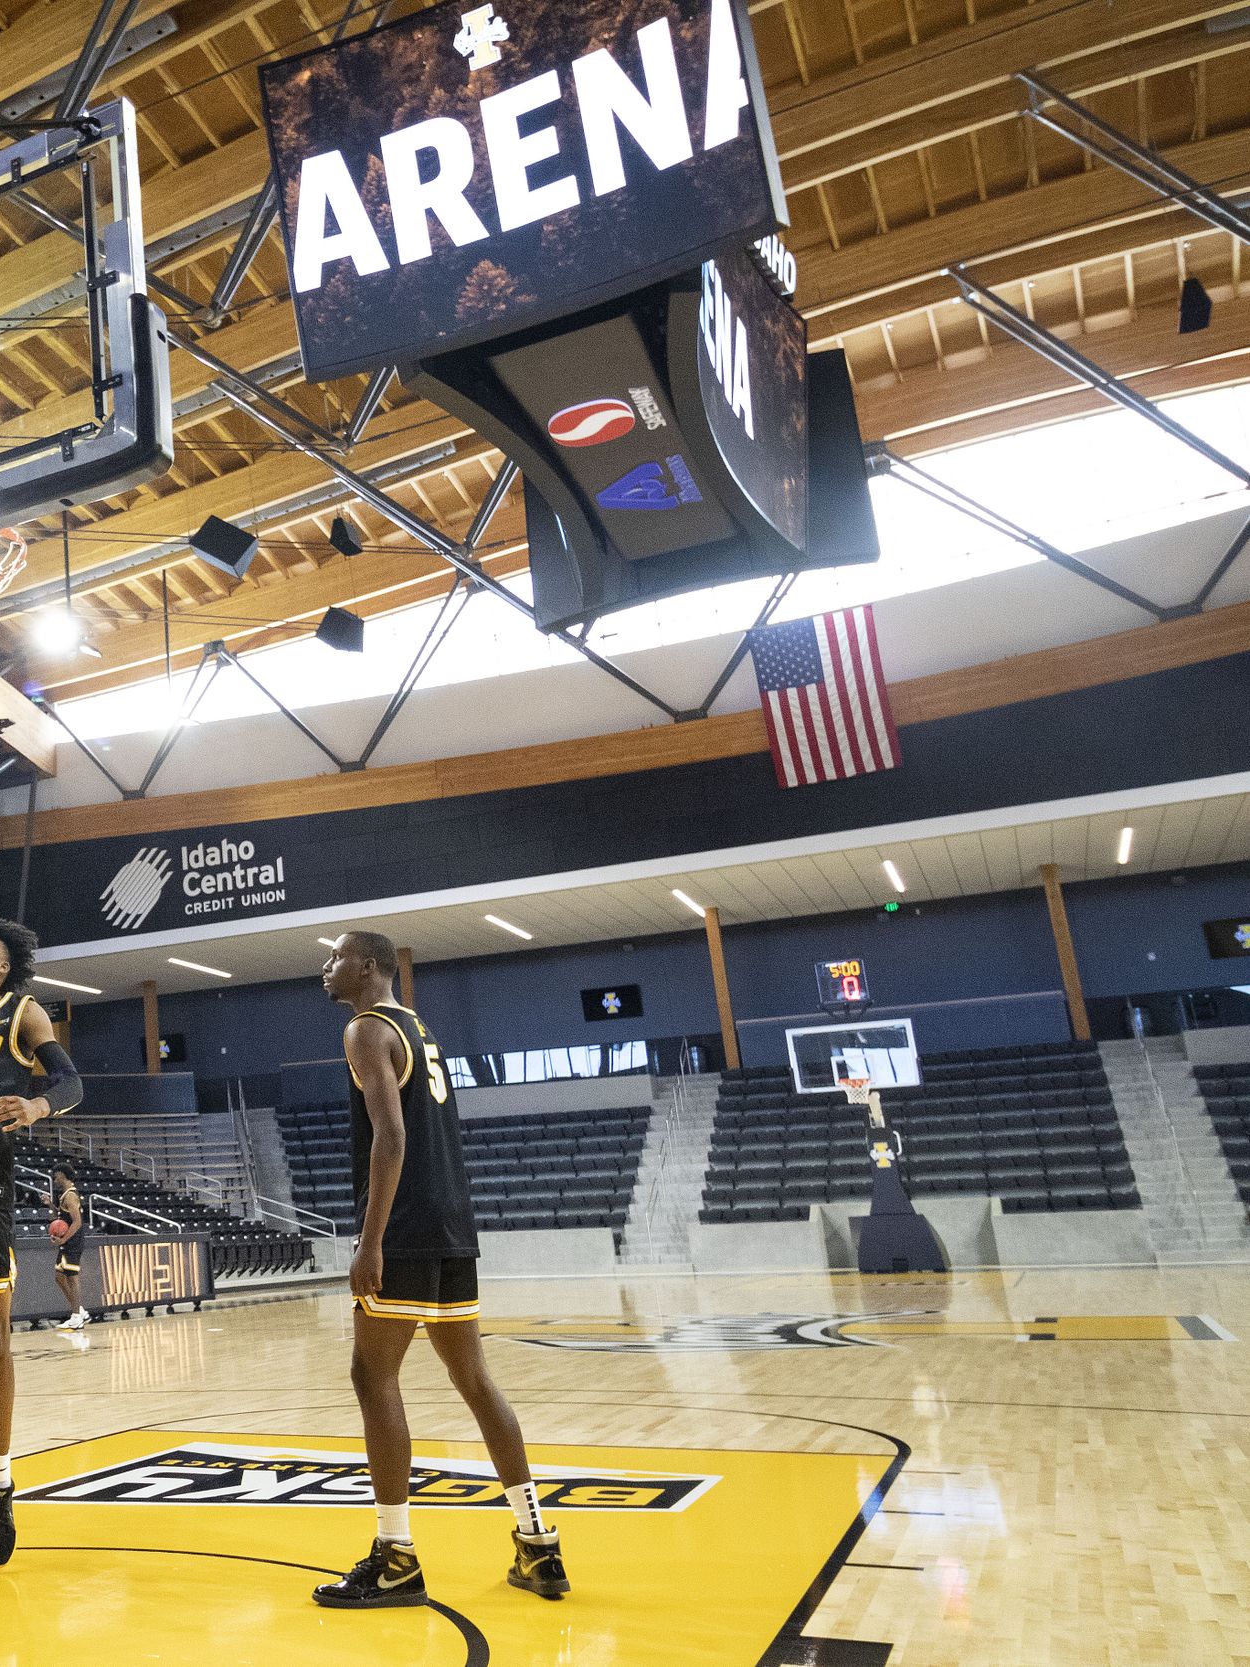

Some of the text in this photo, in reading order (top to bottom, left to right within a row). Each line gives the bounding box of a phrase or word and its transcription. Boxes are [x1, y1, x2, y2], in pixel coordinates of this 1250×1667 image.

[753, 233, 797, 296] AHO
[181, 838, 255, 871] Idaho
[183, 856, 284, 897] Central
[184, 889, 286, 915] CREDIT UNION
[830, 961, 860, 978] 5:00
[842, 976, 861, 1000] 0
[423, 1042, 448, 1104] 5
[45, 1465, 423, 1501] SKY
[158, 1458, 440, 1477] CNFERENCE
